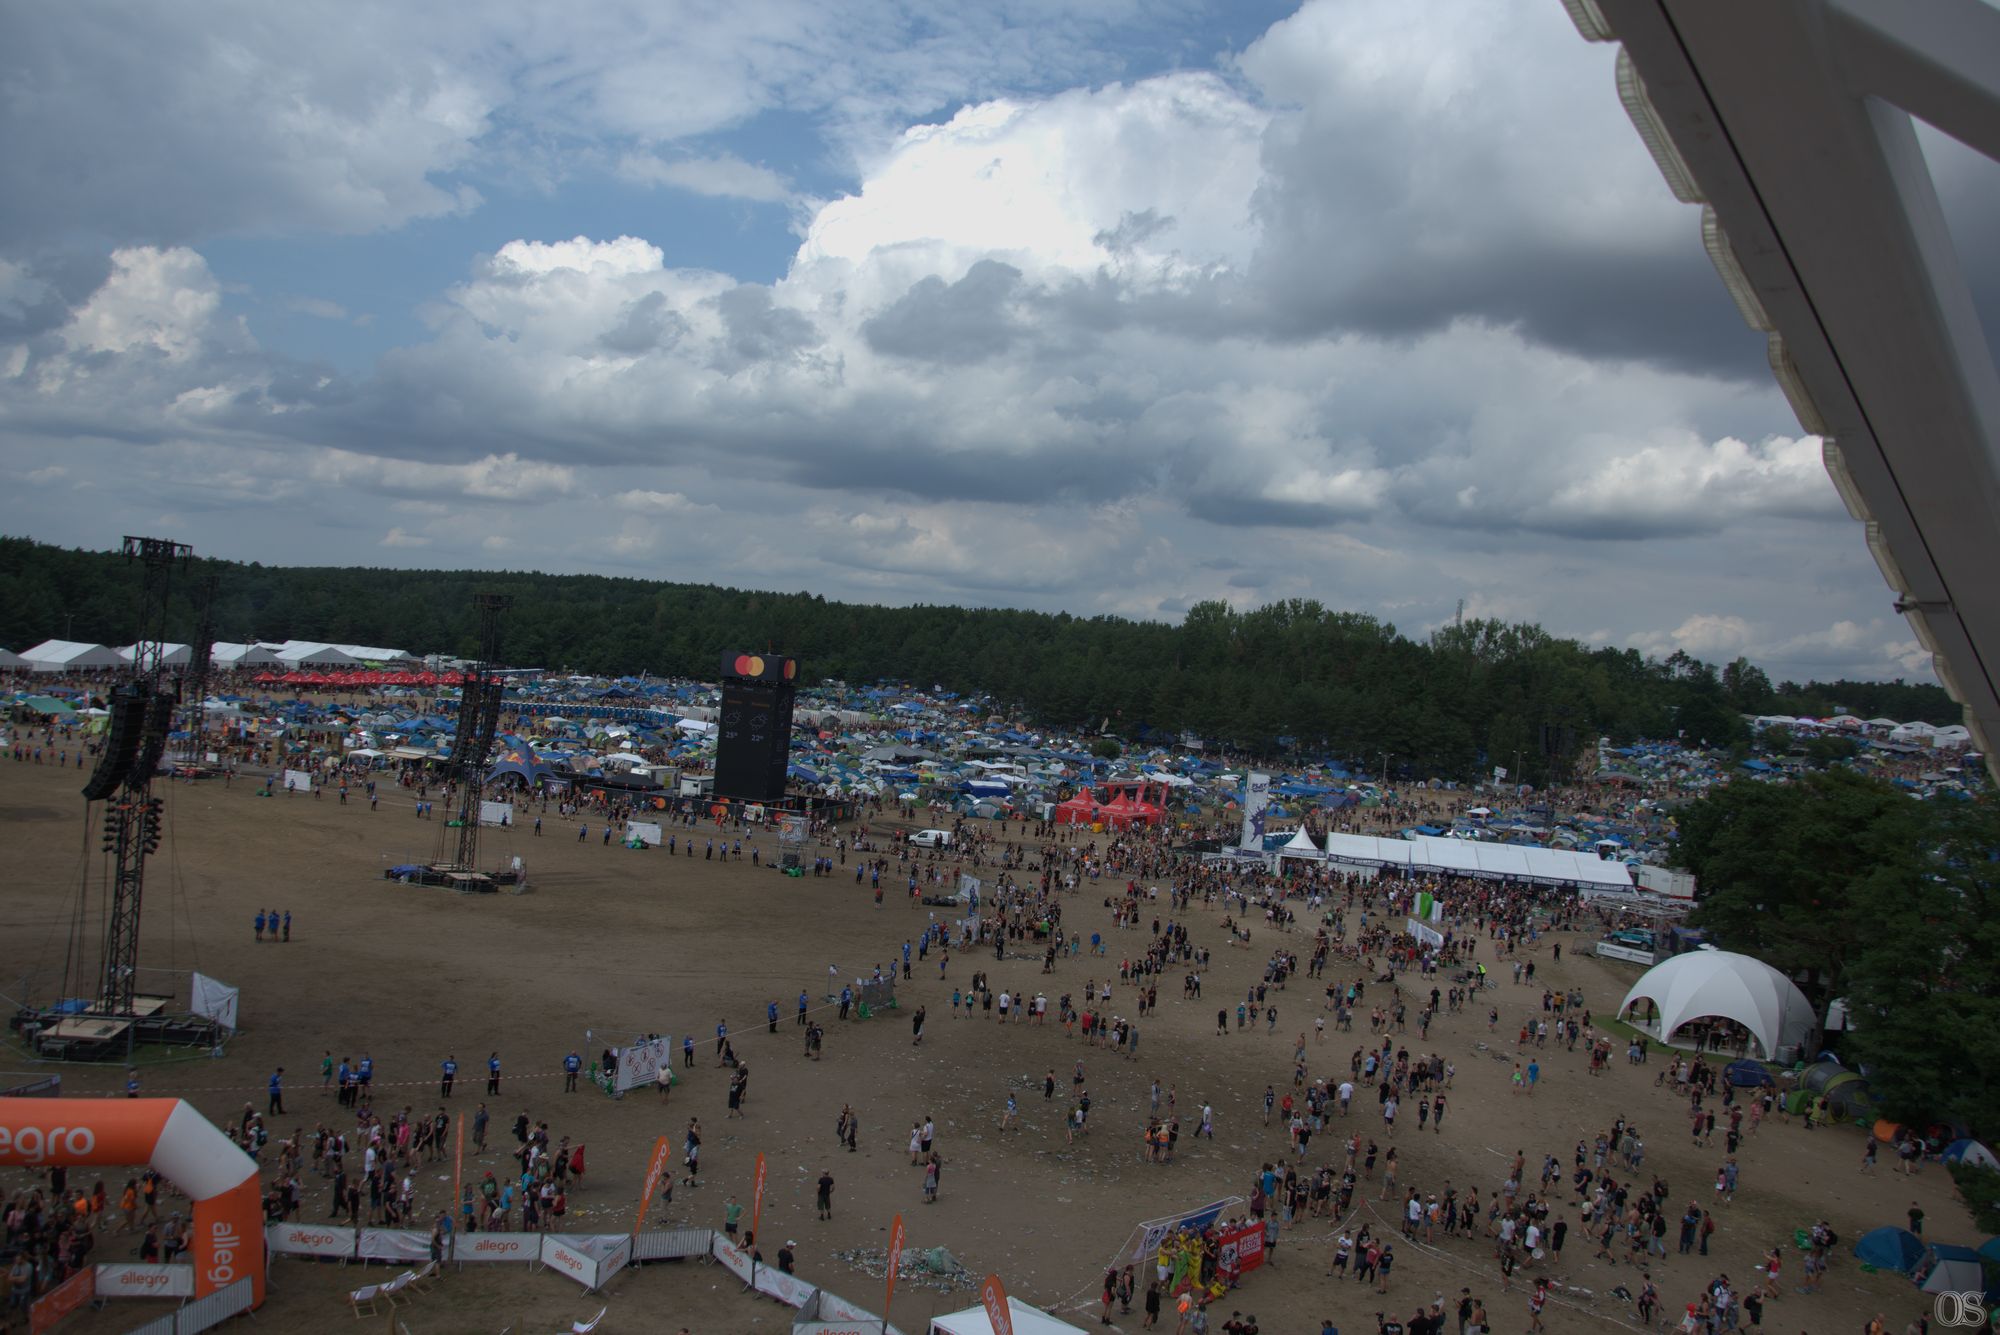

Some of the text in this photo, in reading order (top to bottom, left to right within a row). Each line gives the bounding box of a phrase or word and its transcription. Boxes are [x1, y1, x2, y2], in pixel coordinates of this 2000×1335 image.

[289, 1231, 334, 1246] allegro
[475, 1239, 519, 1254] allegro
[554, 1249, 583, 1271] allegro
[120, 1272, 169, 1287] allegro
